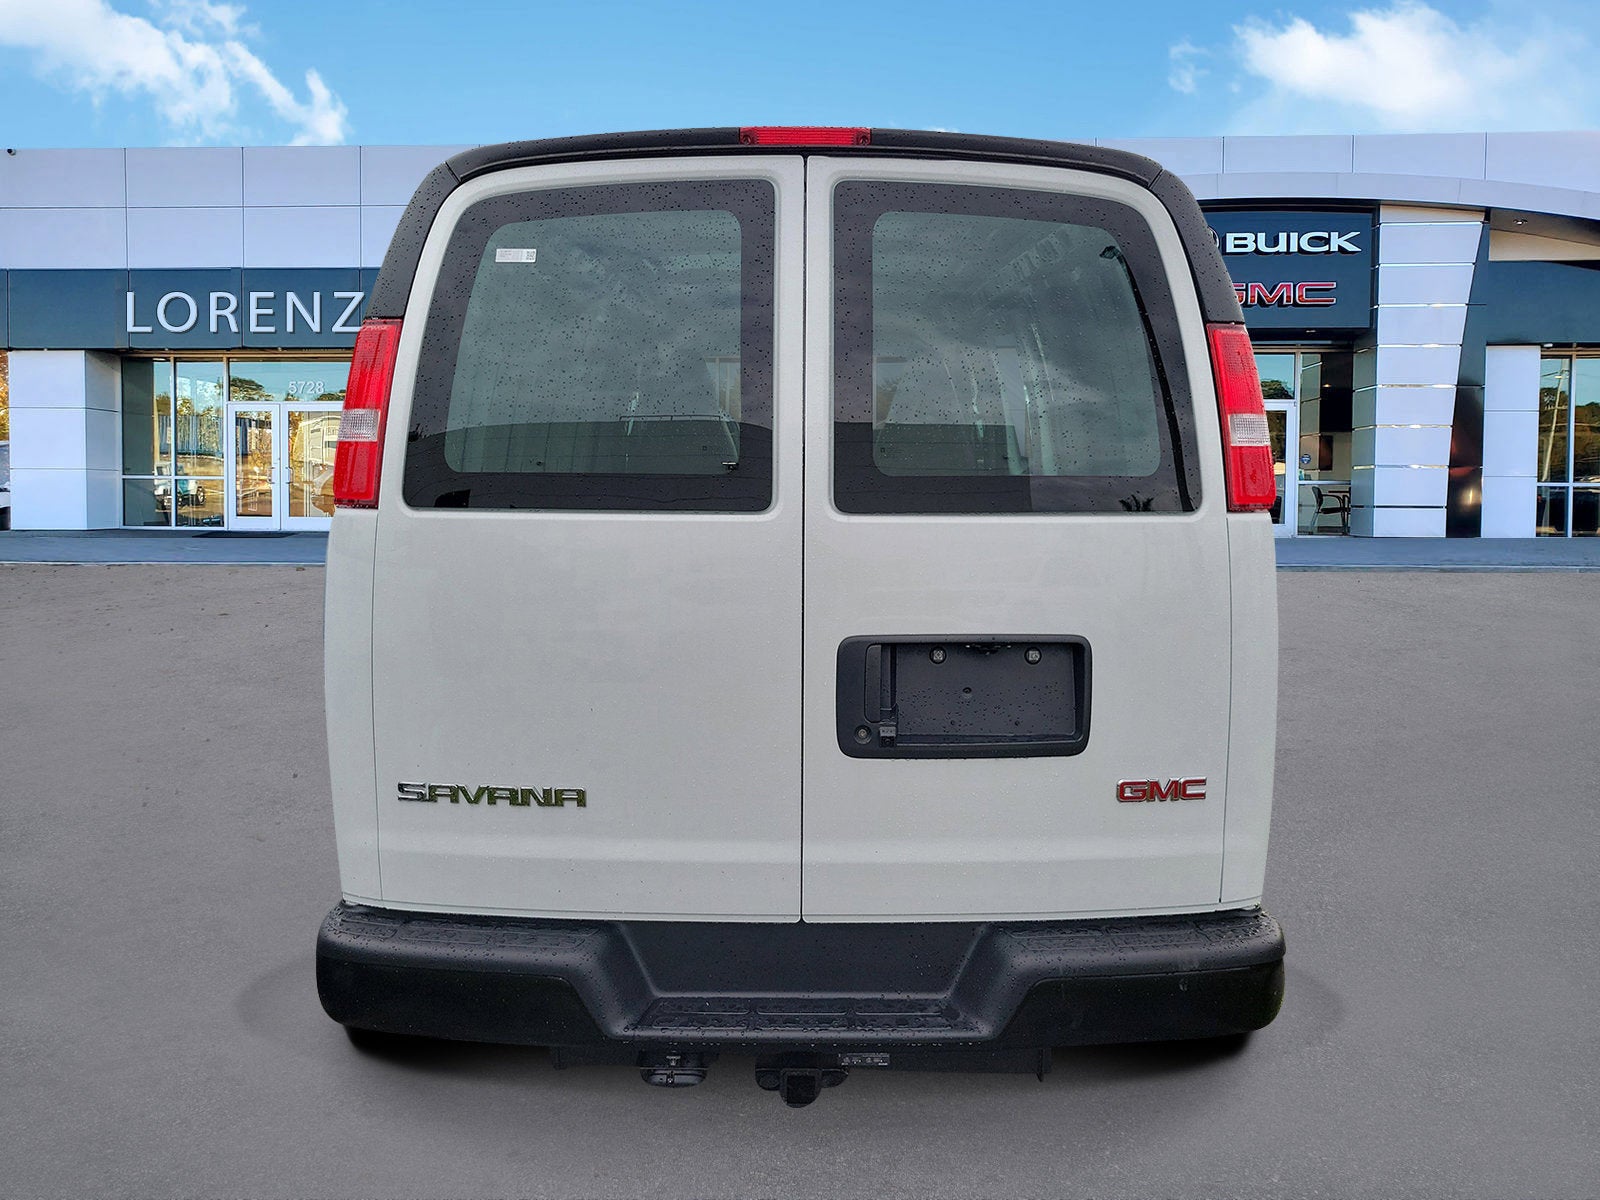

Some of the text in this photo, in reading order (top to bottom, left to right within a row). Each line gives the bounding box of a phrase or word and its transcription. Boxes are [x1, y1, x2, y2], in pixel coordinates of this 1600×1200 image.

[1226, 231, 1362, 253] BUICK
[126, 291, 365, 333] LORENZ
[288, 380, 325, 394] 5728
[397, 781, 587, 807] SAVANA
[1117, 776, 1207, 802] GMC
